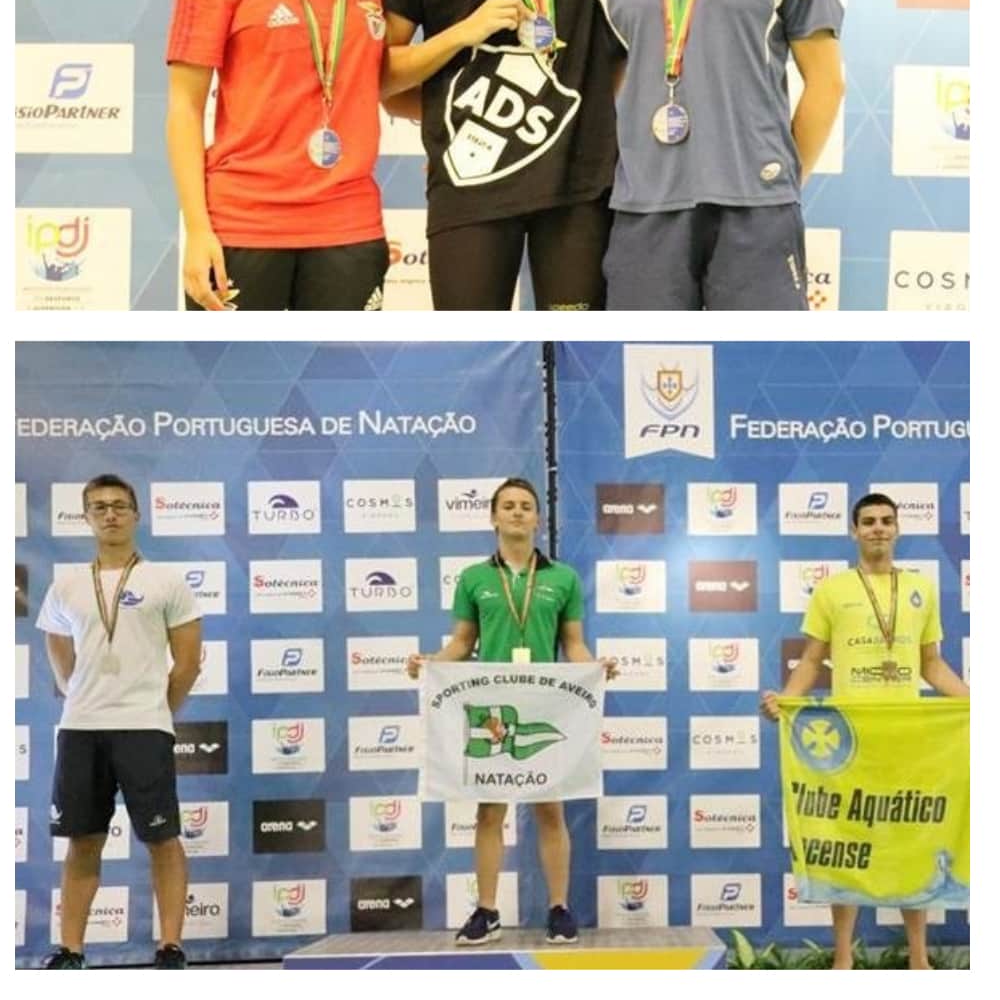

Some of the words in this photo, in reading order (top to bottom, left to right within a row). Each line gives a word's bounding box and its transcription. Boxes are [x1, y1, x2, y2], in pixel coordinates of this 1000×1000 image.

[452, 76, 554, 144] ADS
[154, 411, 315, 436] PORTUGUESA
[321, 419, 351, 435] DE
[358, 410, 476, 439] NATAÇÃO
[731, 414, 866, 444] FEDERAÇÃO
[155, 497, 221, 511] Sotécnica
[603, 504, 634, 514] arena
[253, 509, 314, 521] TURBO
[254, 575, 318, 588] Sotécnica
[696, 581, 727, 592] arena
[352, 586, 412, 598] TURBO
[432, 676, 491, 710] SPORTING
[494, 674, 536, 686] CLUBE
[538, 677, 556, 687] DE
[558, 681, 598, 710] AVEIRO
[601, 731, 663, 745] Sotécnica
[475, 772, 548, 787] NATAÇÃO
[792, 782, 842, 820] lube
[847, 788, 946, 828] Aquático
[694, 809, 756, 823] Sotécnica
[261, 821, 293, 832] arena
[358, 900, 390, 909] arena
